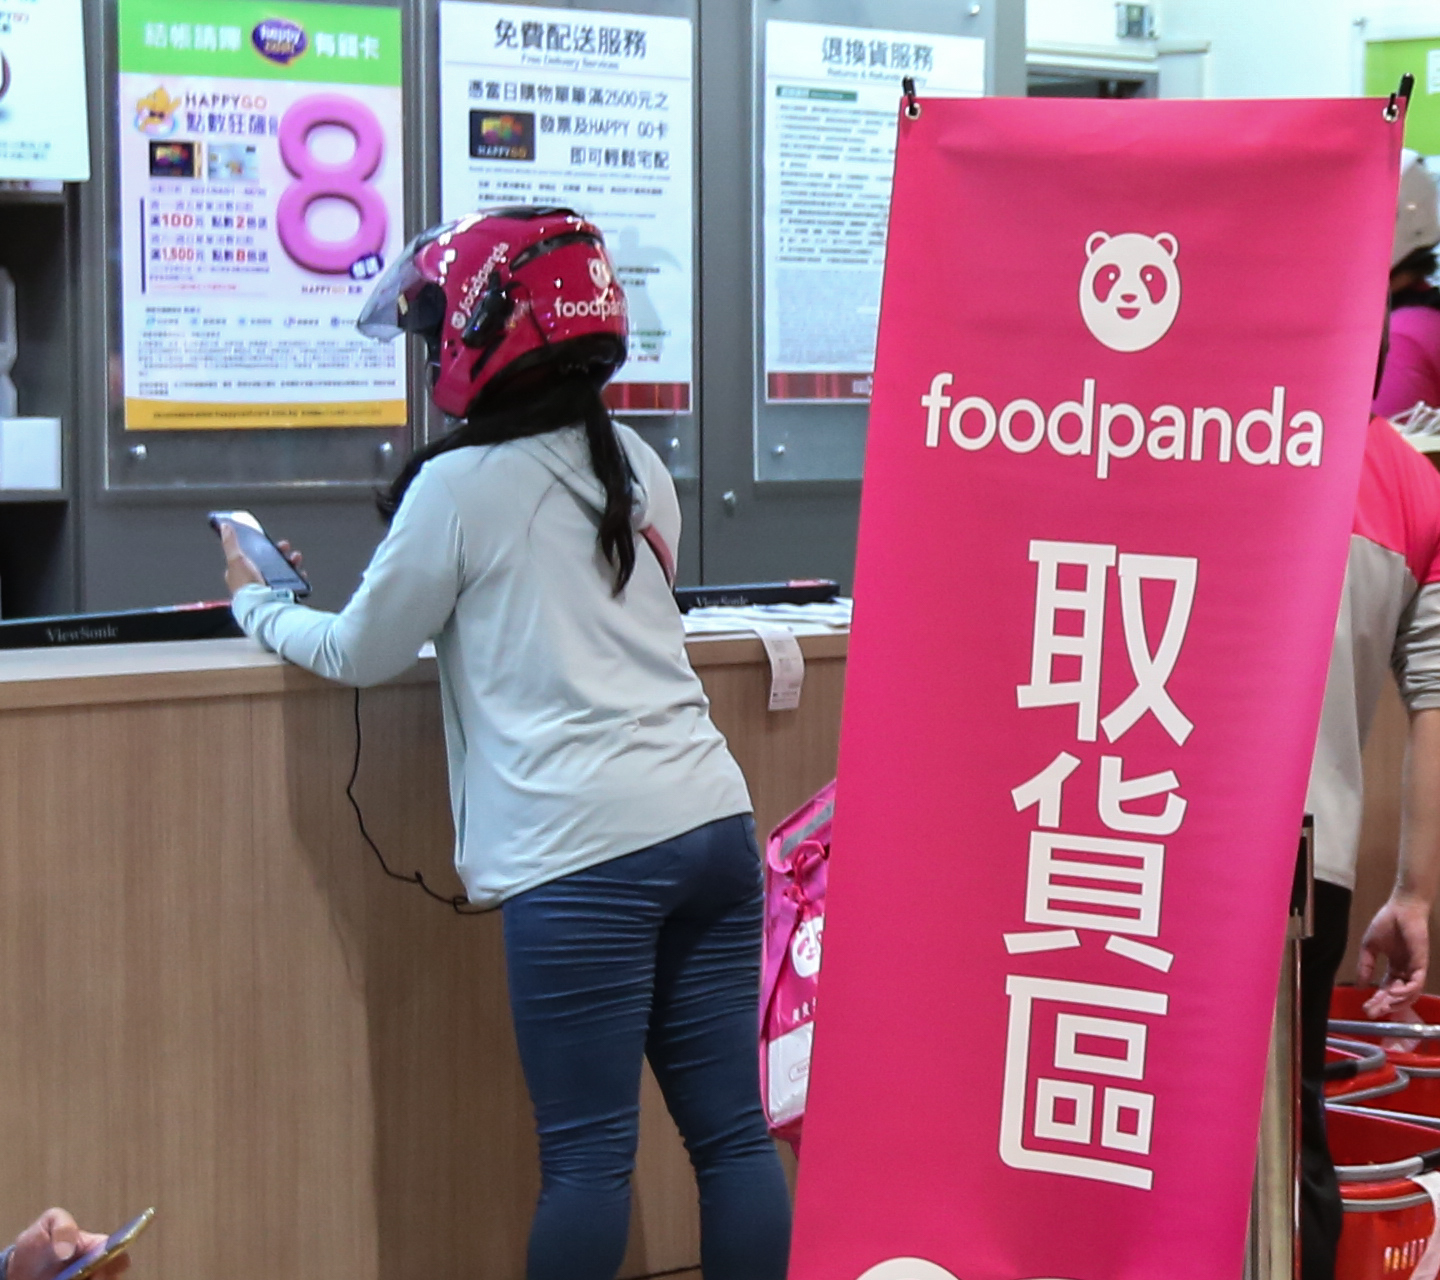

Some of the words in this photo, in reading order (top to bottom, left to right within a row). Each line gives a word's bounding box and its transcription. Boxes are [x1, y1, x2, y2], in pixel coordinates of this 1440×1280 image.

[494, 18, 647, 60] 免費配送服務
[822, 35, 934, 73] 退換貨服務
[276, 92, 388, 277] 8
[553, 295, 629, 322] foodpan
[921, 372, 1325, 480] foodpanda
[45, 623, 120, 642] ViewSonic
[999, 539, 1198, 1191] 取貨區
